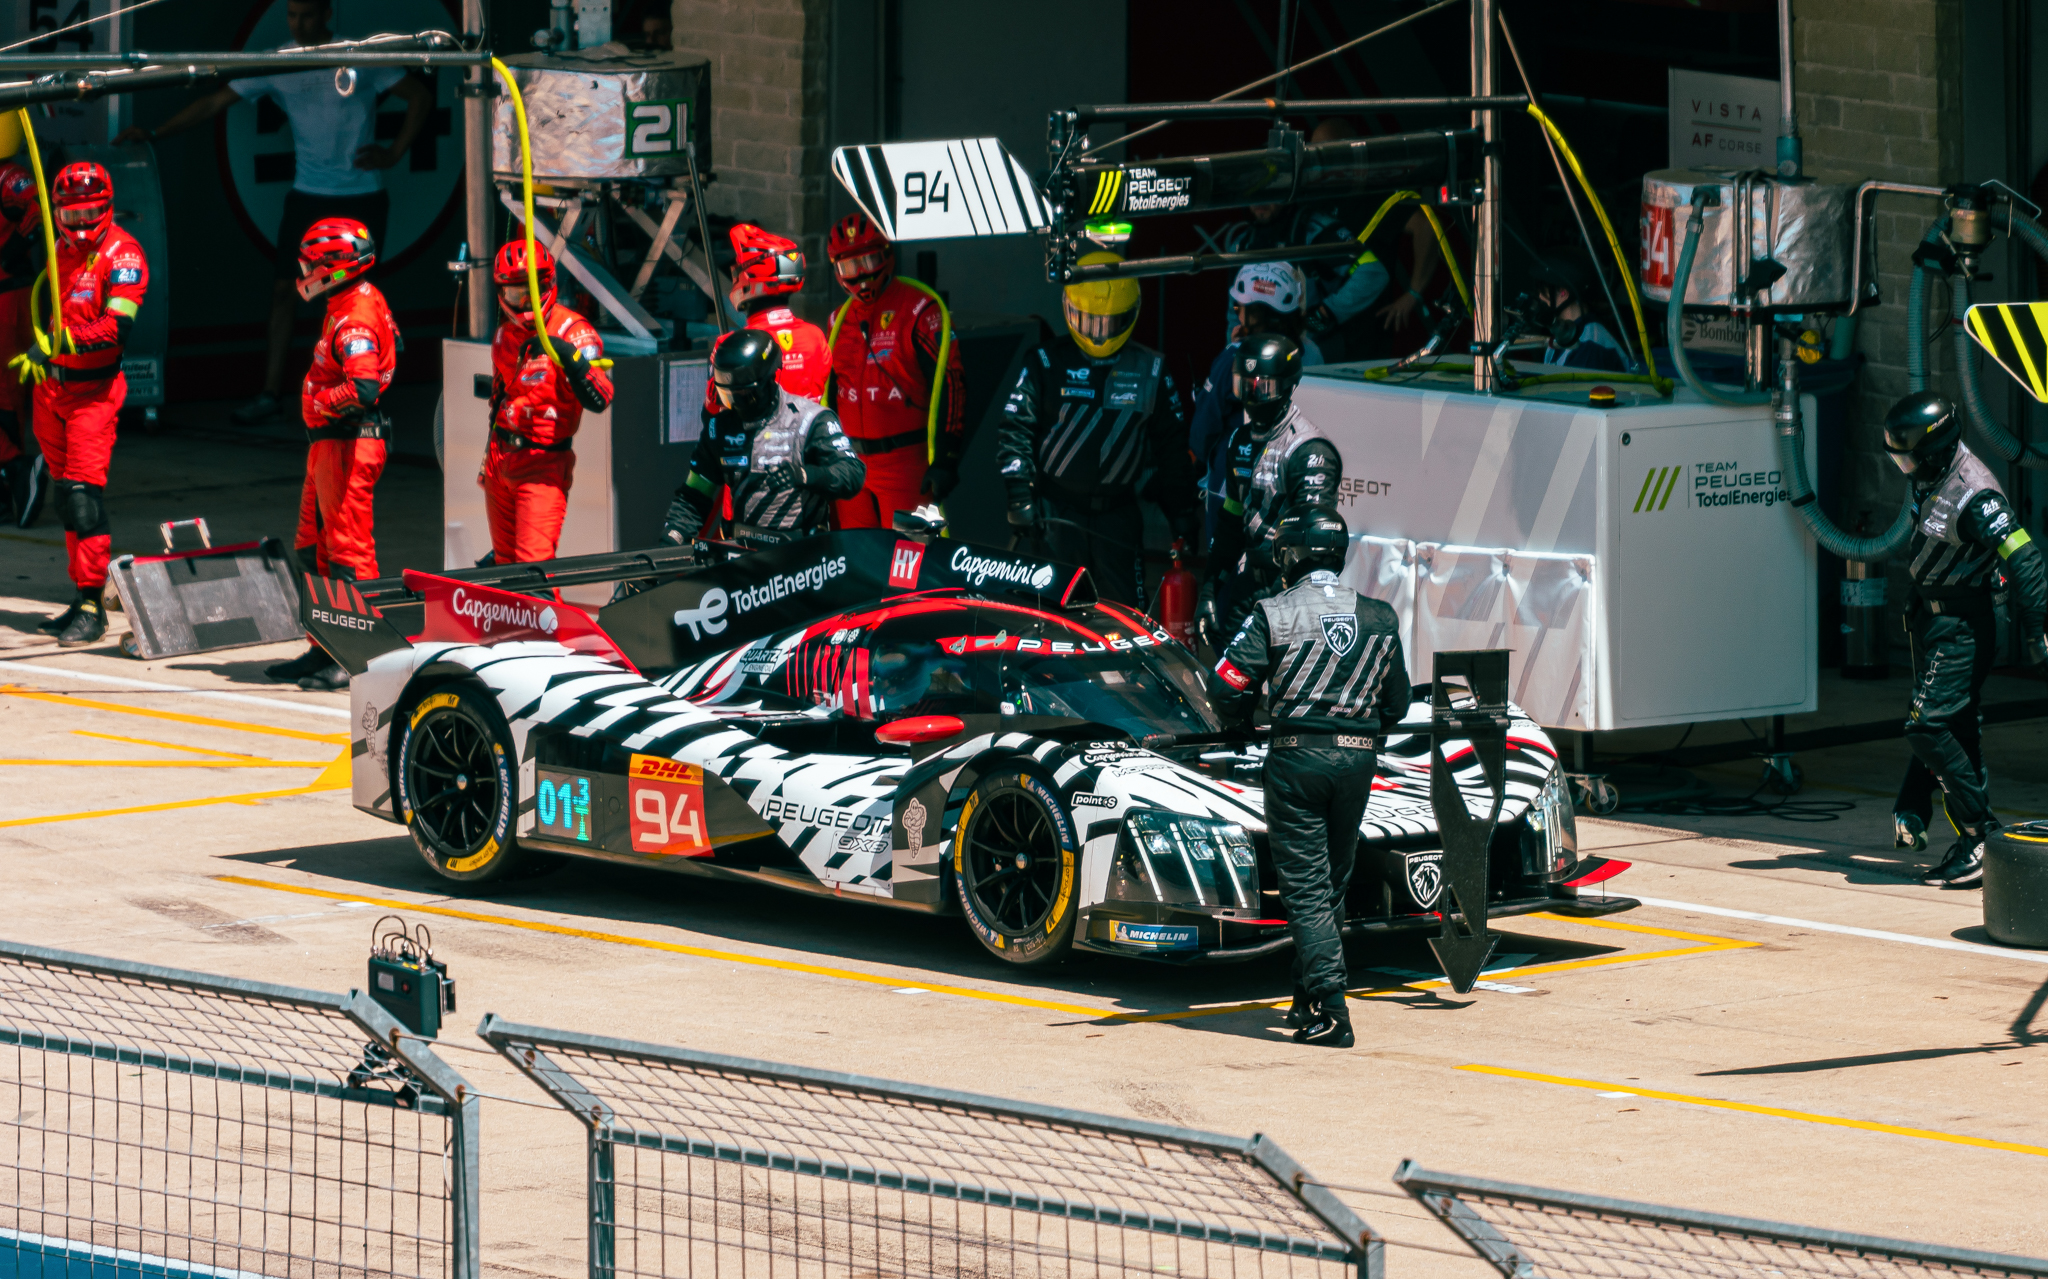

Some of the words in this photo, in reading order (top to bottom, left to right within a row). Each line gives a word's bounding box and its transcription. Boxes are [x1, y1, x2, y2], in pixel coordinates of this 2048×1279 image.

[1692, 99, 1761, 121] VISTA
[632, 102, 688, 153] 21
[1692, 132, 1713, 147] AF
[1719, 138, 1761, 154] CORSE
[1129, 168, 1157, 180] TEAM
[904, 170, 949, 215] 94
[1129, 177, 1191, 195] PEUGEOT
[1129, 192, 1189, 212] TotalEnergies
[1700, 323, 1746, 344] Bombar
[507, 404, 558, 420] STA
[1695, 461, 1737, 473] TEAM
[1340, 477, 1392, 497] GEOT
[1695, 471, 1782, 490] PEUGEO
[739, 529, 782, 544] PEUGEOT
[892, 548, 921, 580] HY
[951, 545, 1037, 587] Capgemini
[730, 555, 847, 615] TotalEnergies
[312, 608, 376, 632] PEUGEOT
[452, 587, 539, 633] Capgemini
[1016, 629, 1170, 652] PEUGEO
[741, 648, 782, 663] QUARTZ
[1337, 735, 1373, 747] sparco
[640, 759, 693, 780] DHL
[496, 768, 511, 838] MICHELIN
[538, 778, 573, 829] 01
[1075, 795, 1104, 806] point
[635, 788, 703, 847] 94
[766, 799, 890, 834] PEUGEOT
[1036, 786, 1070, 844] MICHELIN
[838, 835, 889, 854] 9X8
[1409, 855, 1443, 864] PEUGEOT
[1130, 930, 1189, 941] MICHELIN
